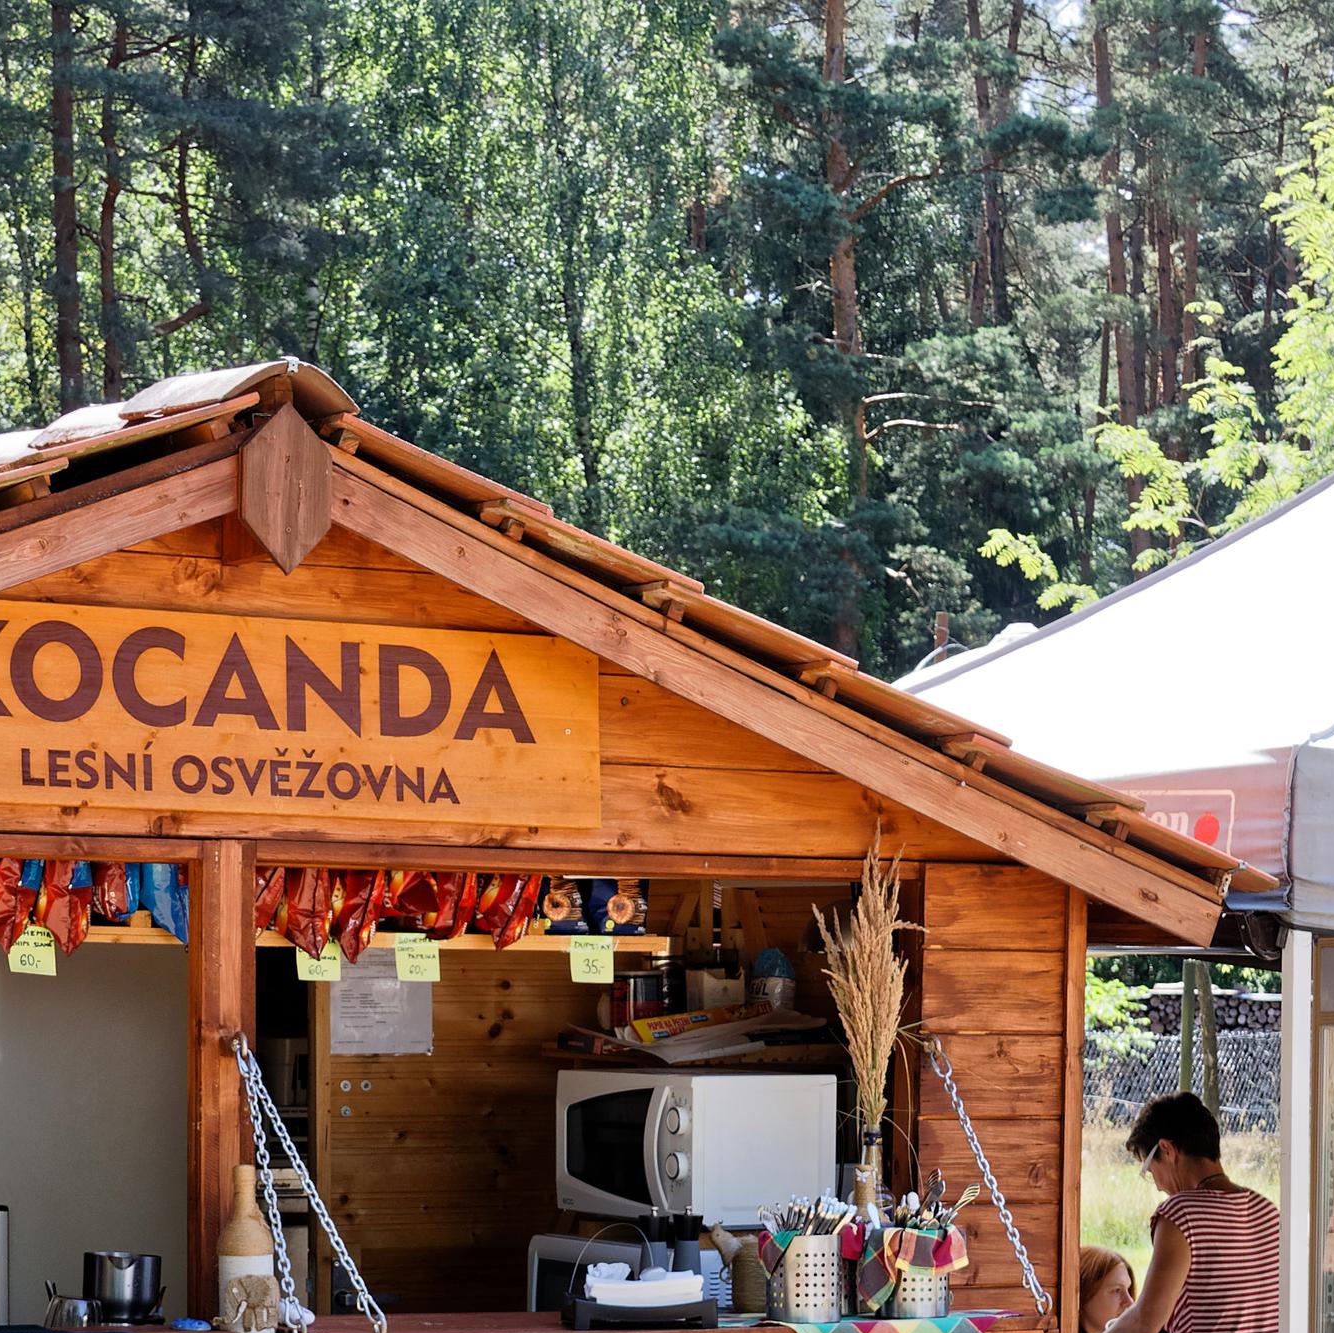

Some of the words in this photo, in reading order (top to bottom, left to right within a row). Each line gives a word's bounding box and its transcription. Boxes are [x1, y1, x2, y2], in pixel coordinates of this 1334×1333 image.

[20, 741, 155, 792] LESNÍ
[170, 747, 462, 805] OSVĚŽOVNA
[23, 929, 53, 939] HEMIA
[20, 953, 42, 968] 60,-
[582, 959, 605, 975] 35,-
[308, 964, 329, 977] 60,-
